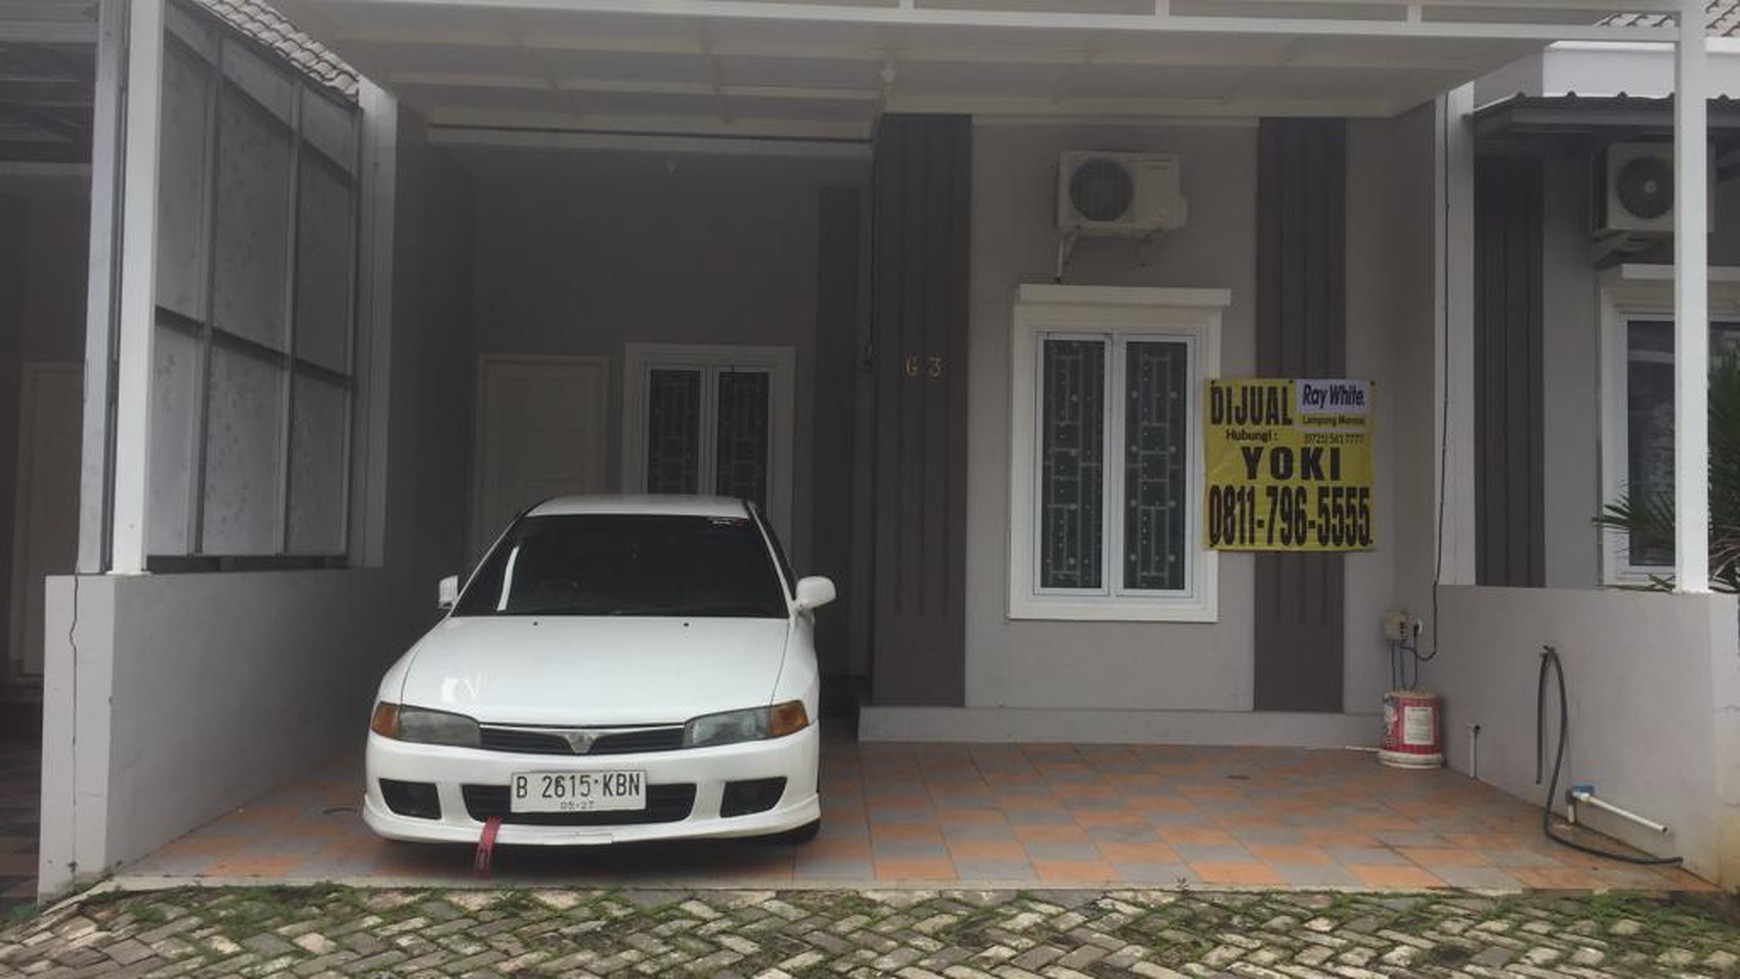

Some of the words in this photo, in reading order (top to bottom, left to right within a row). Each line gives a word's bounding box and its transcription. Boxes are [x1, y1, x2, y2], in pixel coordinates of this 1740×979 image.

[929, 356, 942, 378] 3
[1210, 385, 1293, 425] DIJUAL
[1302, 383, 1328, 409] Ray
[1225, 429, 1272, 443] Hubungi
[1240, 446, 1341, 481] YOKI
[1208, 484, 1371, 547] 0811-796-5555
[516, 776, 528, 799] B
[541, 774, 591, 798] 2615
[602, 773, 640, 797] KBN
